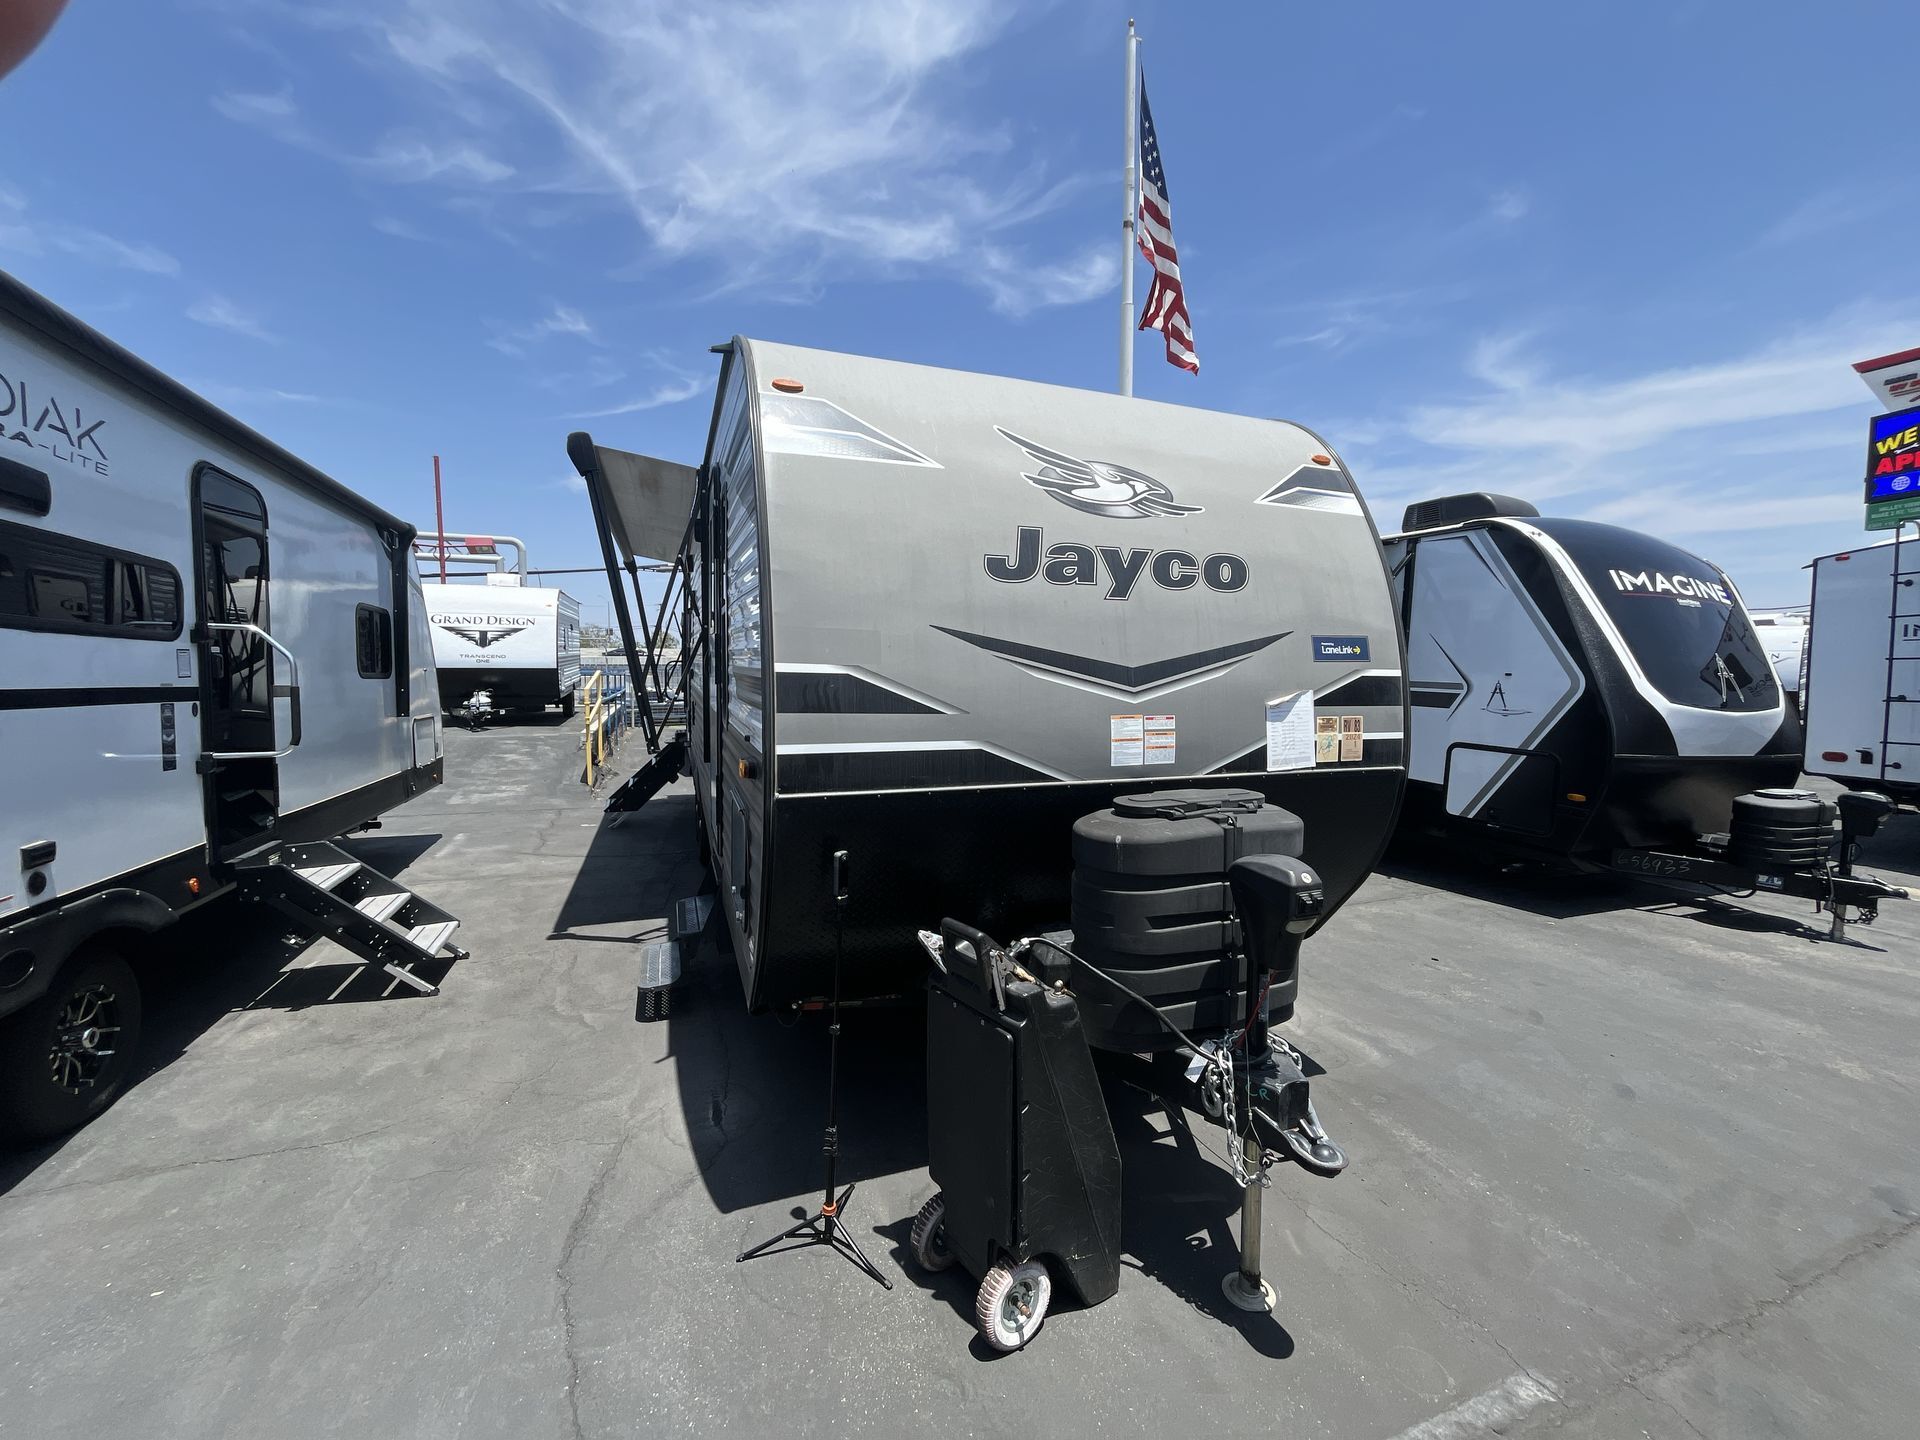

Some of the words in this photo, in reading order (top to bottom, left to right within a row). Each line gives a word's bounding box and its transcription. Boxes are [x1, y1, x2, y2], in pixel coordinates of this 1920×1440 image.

[1876, 426, 1918, 455] WE
[984, 525, 1249, 601] Jayco
[1608, 569, 1732, 606] IMAGINE
[430, 614, 482, 625] GRAND
[487, 616, 536, 626] DESIGN
[1321, 645, 1354, 655] LaneLink
